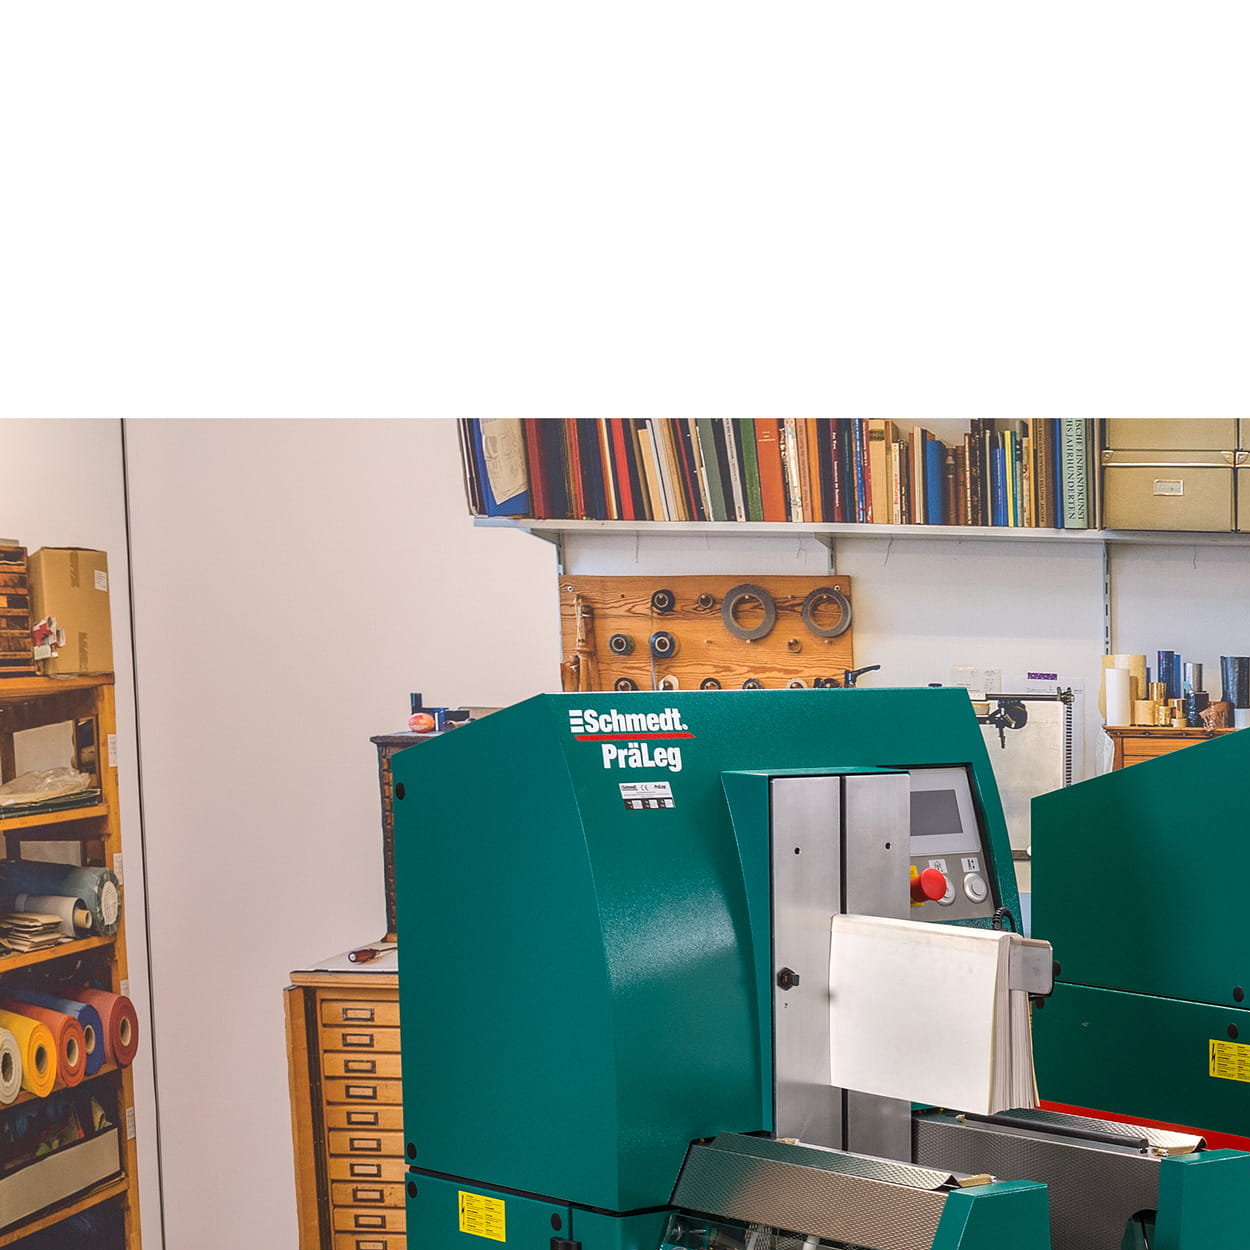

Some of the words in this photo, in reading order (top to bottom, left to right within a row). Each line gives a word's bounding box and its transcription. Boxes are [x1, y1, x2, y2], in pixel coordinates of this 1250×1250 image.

[1065, 433, 1076, 520] JAHRHUNDERTEN
[1076, 448, 1085, 520] EINBANDKUNST
[601, 742, 683, 772] PräLeg
